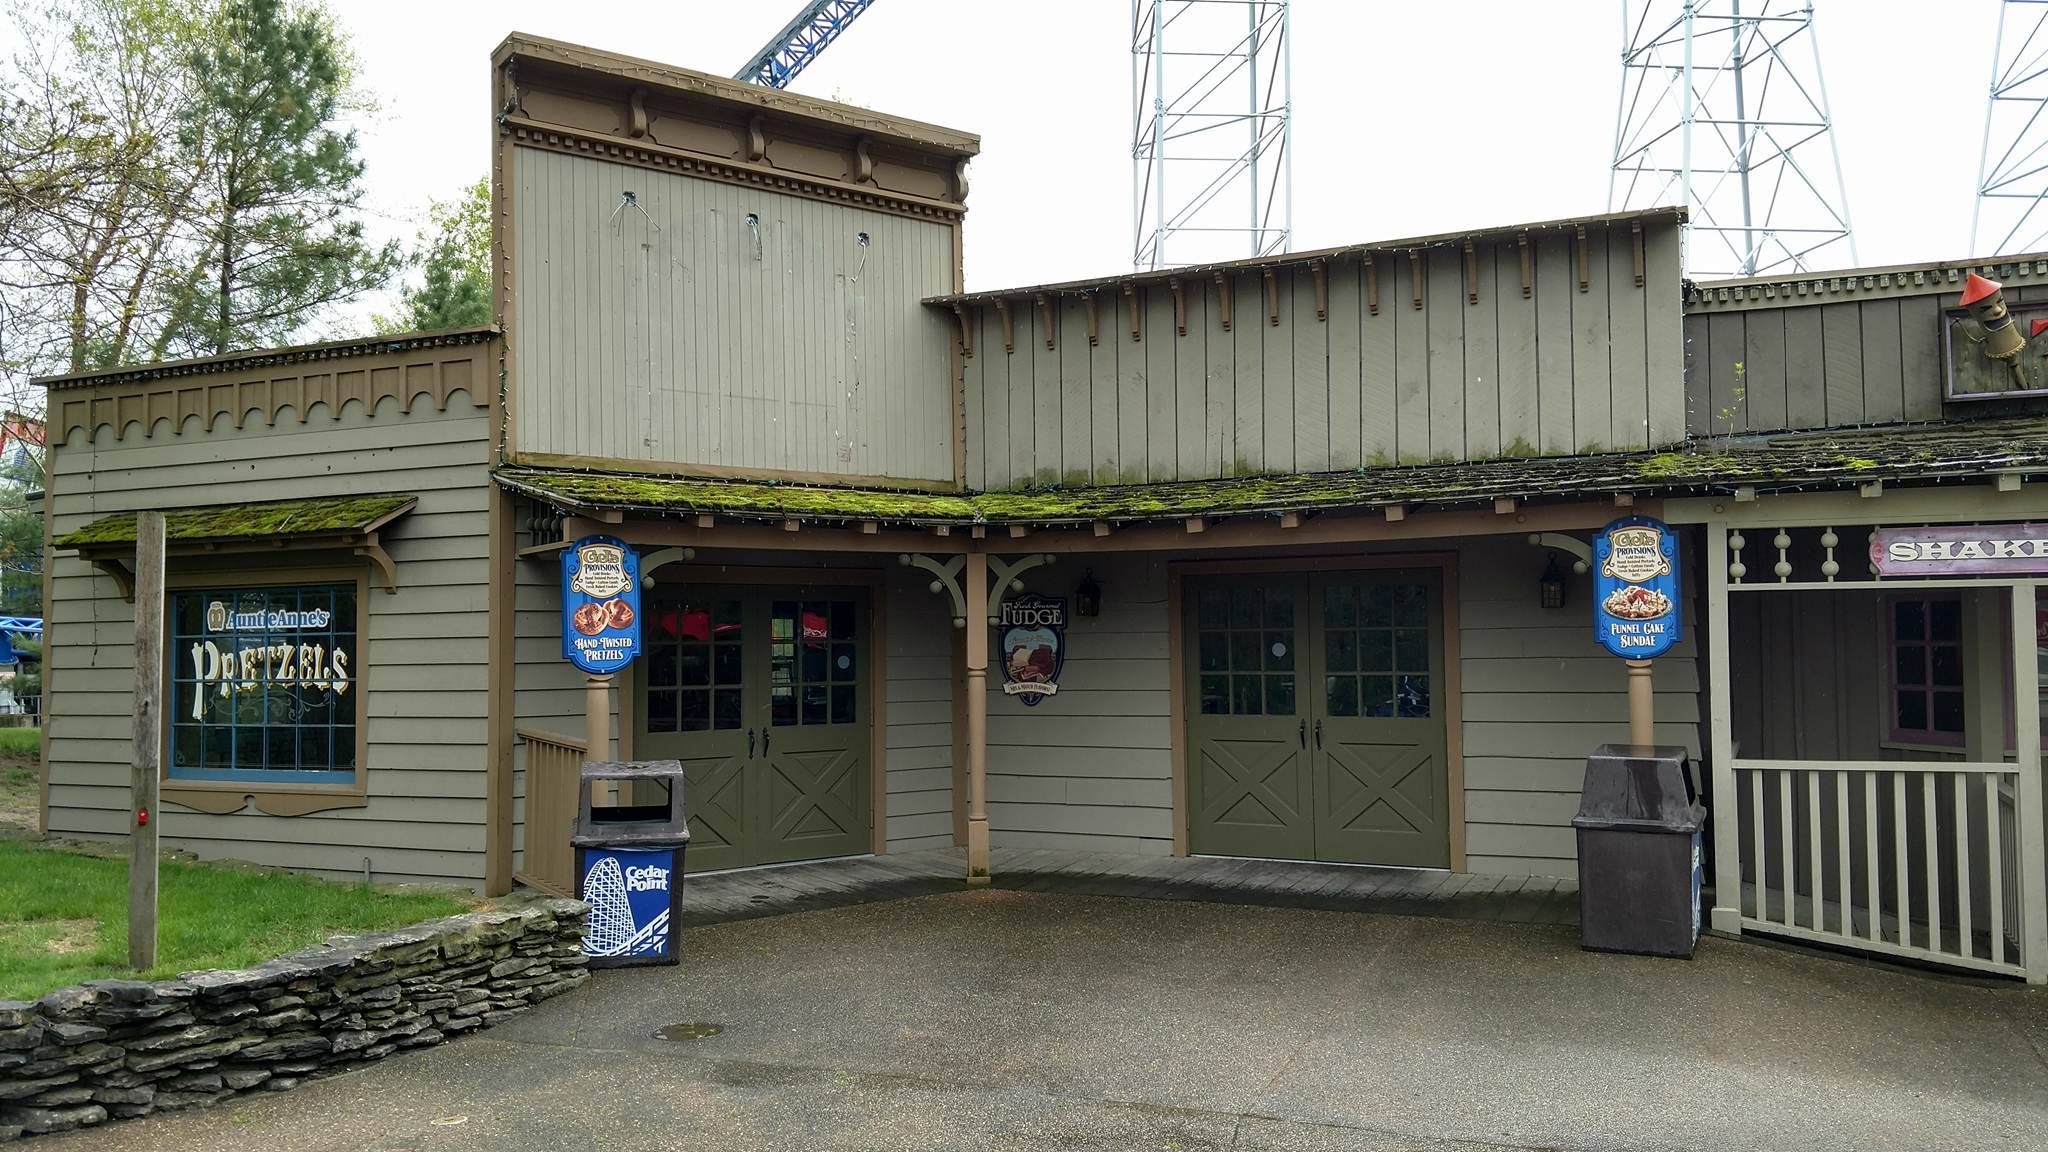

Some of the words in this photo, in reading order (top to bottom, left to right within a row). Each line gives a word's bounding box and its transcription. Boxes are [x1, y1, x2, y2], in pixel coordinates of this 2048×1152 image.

[1616, 547, 1656, 558] PROVISIONS
[583, 564, 620, 574] PROVISIONS
[1001, 602, 1062, 625] FUDGE
[1611, 623, 1641, 636] FUNNEL
[1643, 622, 1665, 635] CAKE
[1621, 635, 1656, 648] SUNDAE
[584, 650, 624, 663] PRETZELS
[192, 640, 349, 722] PRETZELS
[625, 865, 669, 879] Cedar
[626, 878, 668, 891] Point
